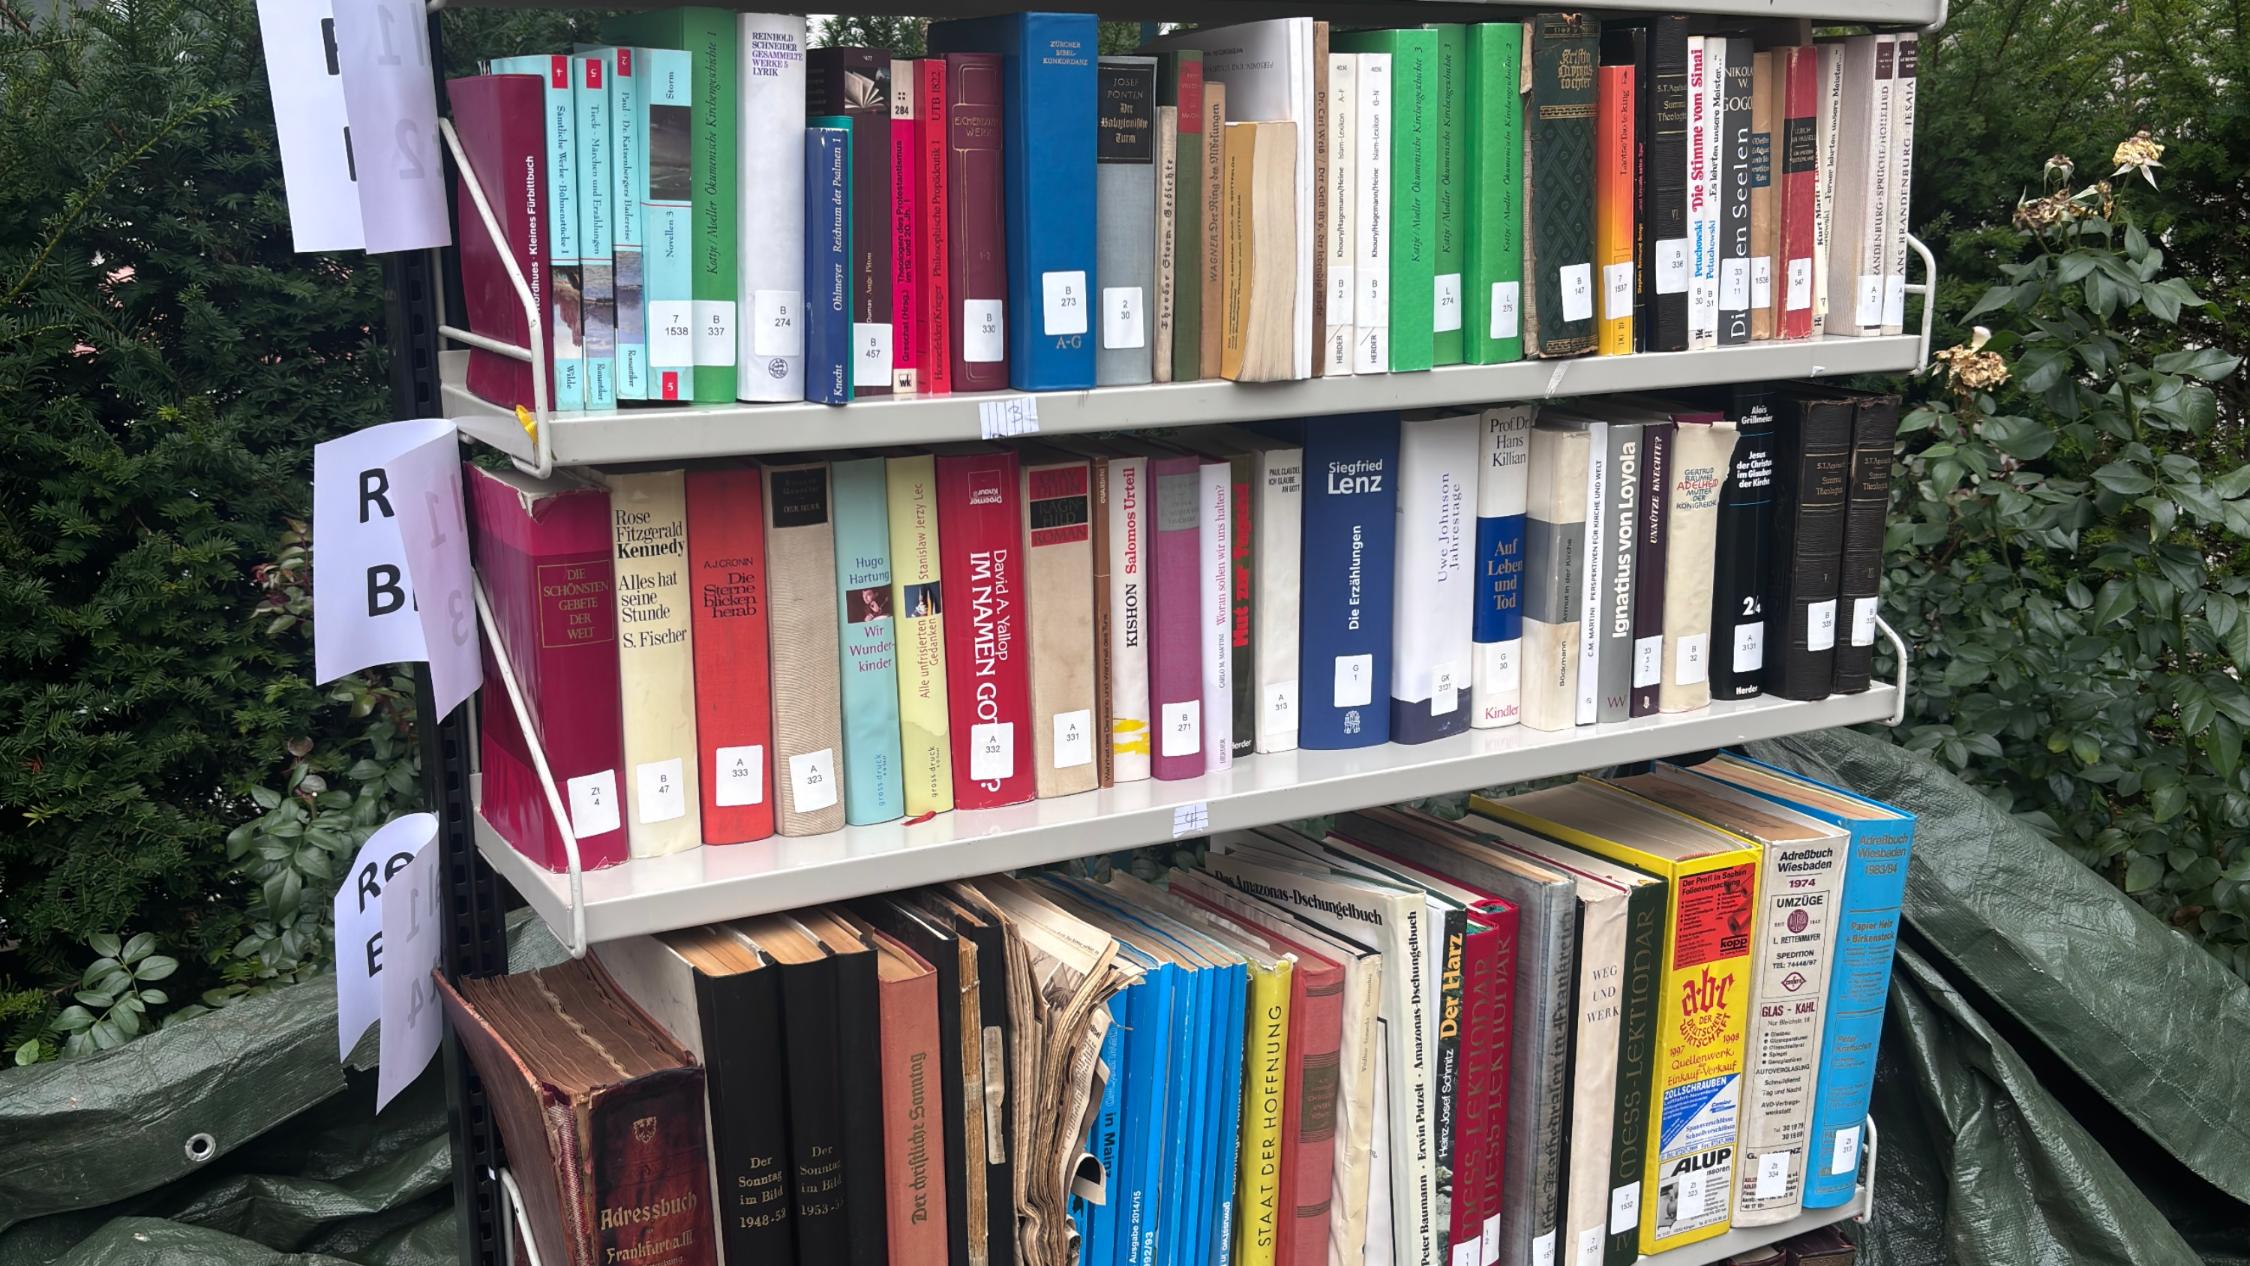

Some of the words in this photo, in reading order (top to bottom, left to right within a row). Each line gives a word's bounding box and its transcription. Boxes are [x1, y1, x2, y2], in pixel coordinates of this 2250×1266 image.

[752, 32, 794, 42] REINHOLD
[752, 42, 798, 51] SCHNEIDER
[752, 50, 803, 61] GESAMMELTE
[752, 59, 782, 68] WERKE
[752, 68, 779, 77] LYRIK
[1691, 49, 1703, 87] Sinai
[666, 72, 675, 99] Storm
[706, 45, 722, 127] Kirchengeschichte
[932, 72, 940, 93] 1822
[591, 104, 599, 127] Tieck
[895, 106, 909, 115] 284
[932, 97, 940, 121] UTB
[1120, 104, 1133, 114] Der
[1693, 92, 1702, 123] vom
[556, 106, 564, 150] Sämtliche
[1114, 132, 1136, 144] Turm
[1691, 124, 1703, 180] Stimme
[706, 132, 720, 196] Ökumenische
[832, 147, 842, 186] Psalmen
[932, 149, 941, 198] Propädeutik
[1733, 127, 1749, 217] Seelen
[527, 156, 535, 215] Fürbittbuch
[832, 188, 842, 205] der
[1692, 182, 1703, 213] Die
[559, 186, 568, 245] Bühnenstücke
[593, 190, 601, 255] Erzählungen
[707, 201, 719, 239] Moeller
[528, 217, 539, 255] Kleines
[666, 221, 675, 258] Novellen
[832, 209, 842, 253] Reichtum
[933, 199, 942, 277] Philosophische
[706, 243, 719, 275] Kottje
[1208, 234, 1218, 282] WAGNER
[1694, 220, 1703, 277] Petuchowski
[833, 263, 844, 311] Ohlmeyer
[1065, 286, 1071, 295] B
[780, 306, 786, 315] B
[1061, 297, 1076, 307] 273
[665, 327, 688, 335] 1538
[775, 316, 790, 327] 274
[1056, 335, 1082, 350] A-G
[566, 365, 575, 389] Wilde
[833, 364, 843, 397] Knecht
[1497, 434, 1524, 448] Hans
[1329, 459, 1383, 475] Siegfried
[1493, 451, 1526, 467] Killian
[1328, 473, 1382, 495] Lenz
[1618, 441, 1636, 509] Loyola
[914, 483, 923, 500] Lec
[1124, 468, 1135, 510] Urteil
[1216, 484, 1225, 519] halten?
[1438, 472, 1450, 542] Johnson
[616, 509, 651, 525] Rose
[916, 504, 926, 531] Jerzy
[1449, 484, 1462, 571] Jahrestage
[616, 522, 683, 543] Fitzgerald
[1617, 511, 1633, 549] von
[617, 539, 684, 558] Kennedy
[1124, 511, 1137, 574] Salomos
[1495, 538, 1517, 556] Auf
[856, 556, 884, 571] Hugo
[919, 533, 928, 580] Stanislaw
[970, 551, 991, 579] IM
[1349, 525, 1363, 605] Erzählungen
[1437, 548, 1447, 582] Uwe
[567, 568, 586, 581] DIE
[849, 569, 889, 586] Hartung
[993, 549, 1008, 593] David
[1218, 562, 1226, 592] sollen
[1488, 559, 1523, 576] Leben
[543, 580, 609, 596] SCHÖNSTEN
[618, 574, 655, 591] Alles
[657, 572, 678, 587] hat
[703, 583, 756, 595] Sterne
[728, 572, 755, 585] Die
[1494, 577, 1517, 591] und
[621, 591, 657, 606] seine
[703, 594, 756, 608] blicken
[995, 598, 1008, 615] A.
[1494, 592, 1516, 610] Tod
[1612, 555, 1630, 638] Ignatius
[570, 613, 592, 625] DER
[622, 605, 671, 623] Stunde
[712, 605, 757, 618] herab
[1126, 583, 1138, 648] KISHON
[1216, 593, 1227, 626] Woran
[1350, 609, 1360, 630] Die
[567, 627, 594, 639] WELT
[623, 632, 637, 648] S.
[639, 627, 687, 648] Fischer
[864, 625, 884, 638] Wir
[929, 618, 938, 666] Gedanken
[971, 586, 996, 677] NAMEN
[996, 616, 1012, 662] Yallop
[849, 640, 896, 656] Wunder-
[918, 619, 929, 678] unfrisierten
[858, 657, 892, 672] kinder
[919, 680, 929, 699] Alle
[1736, 685, 1758, 695] Herder
[1485, 704, 1519, 720] Kindler
[731, 767, 749, 777] 333
[737, 758, 743, 766] A
[659, 785, 670, 793] 47
[660, 774, 666, 783] B
[1780, 848, 1833, 861] Adreßbuch
[1778, 860, 1832, 872] Wiesbaden
[1789, 879, 1816, 888] 1974
[1777, 896, 1823, 908] UMZÜGE
[1721, 938, 1748, 948] kopp
[1443, 933, 1464, 994] Harz
[1776, 950, 1814, 960] SPEDITION
[1592, 965, 1618, 981] WEG
[1407, 910, 1424, 1070] Amazonas-Dschungelbuch
[1592, 985, 1616, 1002] UND
[1440, 997, 1459, 1041] Der
[1586, 1005, 1620, 1023] WERK
[1762, 1005, 1783, 1017] GLAS
[1795, 1002, 1815, 1014] KAHL
[1263, 1005, 1283, 1130] HOFFNUNG
[1442, 1048, 1454, 1088] Schmitz
[908, 1051, 927, 1120] Sonntag
[1416, 1084, 1425, 1123] Patzelt
[1438, 1092, 1452, 1157] Heinz-Josef
[1417, 1126, 1426, 1161] Erwin
[750, 1156, 772, 1169] Der
[1261, 1134, 1276, 1178] DER
[1671, 1148, 1731, 1177] ALUP
[738, 1169, 783, 1187] Sonntag
[740, 1193, 757, 1205] im
[761, 1186, 784, 1203] Bild
[1419, 1175, 1429, 1230] Baumann
[911, 1192, 928, 1224] Der
[1131, 1190, 1142, 1224] 2014/15
[1257, 1185, 1274, 1247] STAAT
[1129, 1226, 1138, 1264] Ausgabe
[1420, 1233, 1430, 1266] Peter
